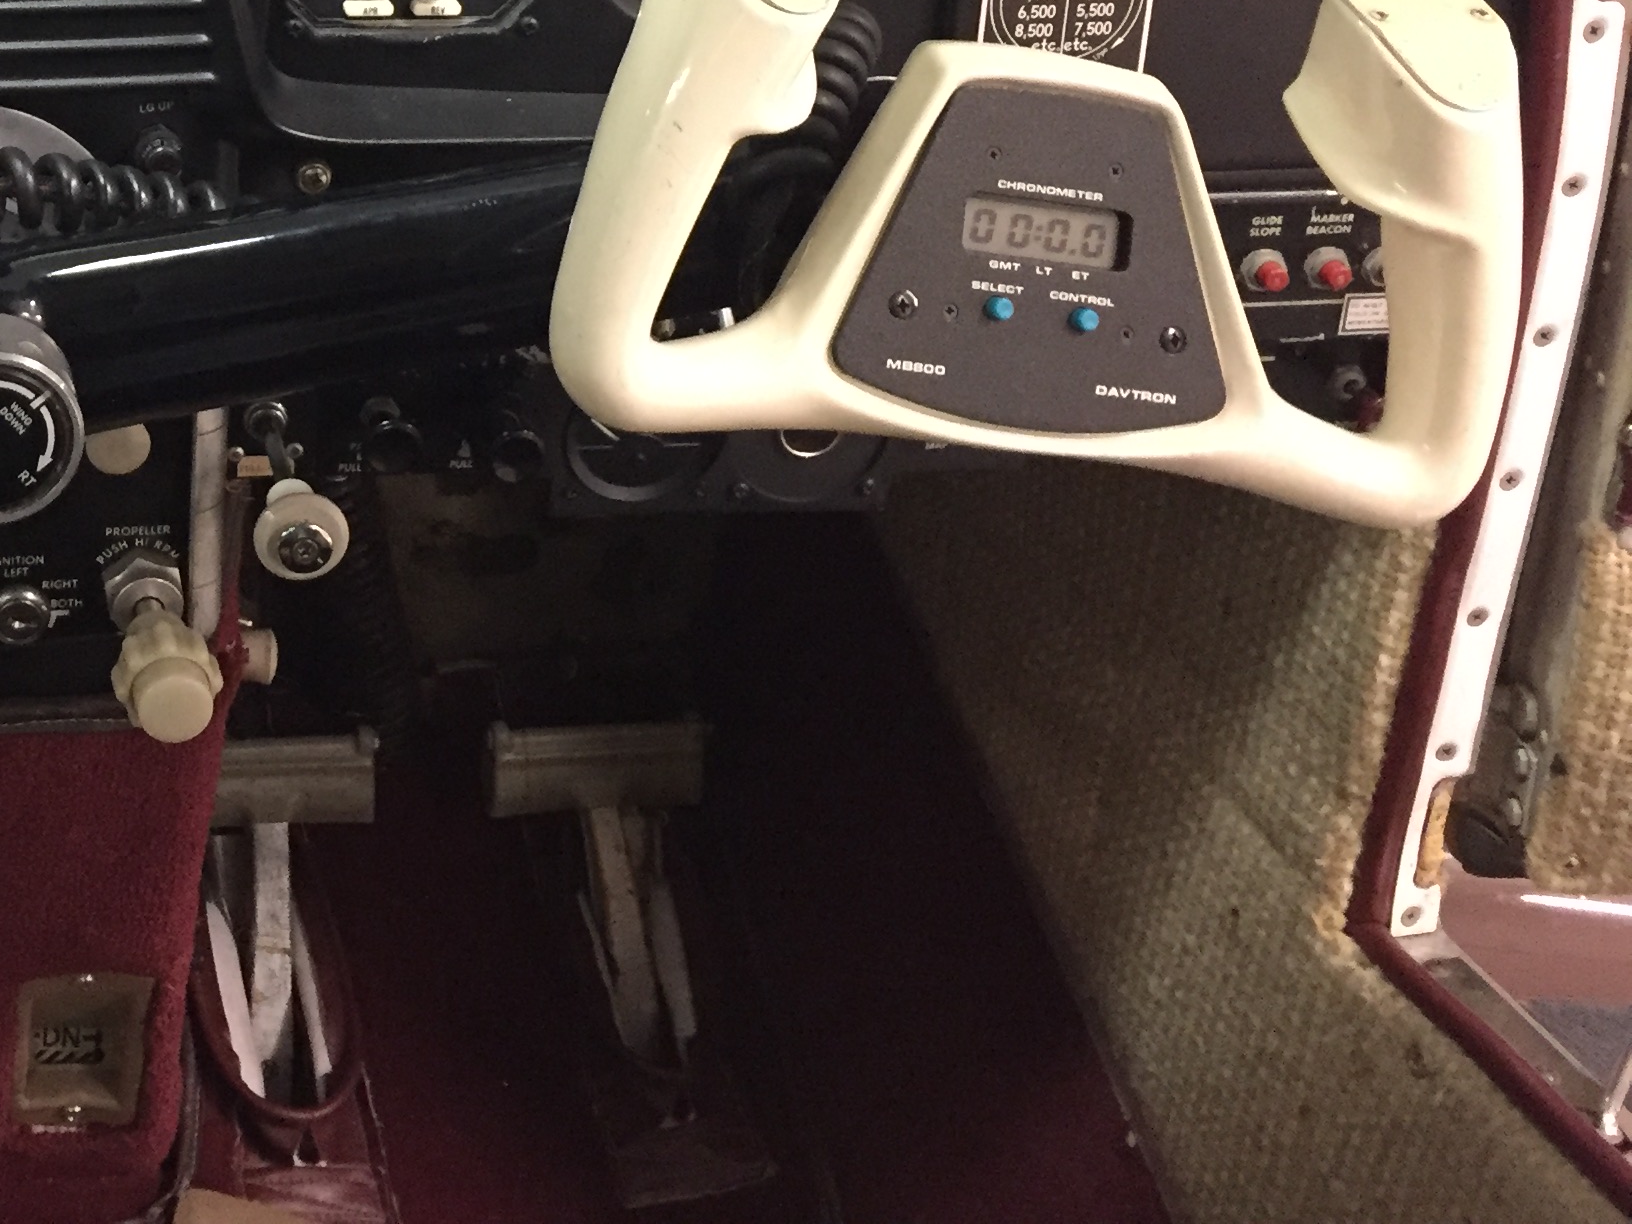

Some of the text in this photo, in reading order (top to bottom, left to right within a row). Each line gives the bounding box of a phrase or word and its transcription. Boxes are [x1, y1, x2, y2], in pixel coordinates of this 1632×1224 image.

[1018, 4, 1056, 20] 6,500
[1076, 2, 1115, 19] 5,500
[1014, 23, 1053, 39] 8,500
[1074, 21, 1112, 37] 7,500
[1064, 37, 1092, 51] etc.
[997, 179, 1104, 202] CHRONOMETER
[1252, 215, 1284, 226] GLIDE
[1310, 213, 1355, 223] MARKER
[1249, 226, 1282, 237] SLOPE
[1306, 225, 1352, 236] BEACON
[989, 259, 1052, 276] GMT LT
[971, 280, 1024, 295] SELECT
[1049, 290, 1115, 308] CONTROL
[1095, 384, 1176, 405] DAVTRON
[0, 406, 26, 436] DOWN
[17, 469, 37, 487] RT
[105, 525, 171, 536] PROPELLER
[96, 539, 128, 565] PUSH
[4, 567, 29, 577] LEFT
[42, 579, 78, 589] RIGHT
[50, 598, 83, 608] BOTH
